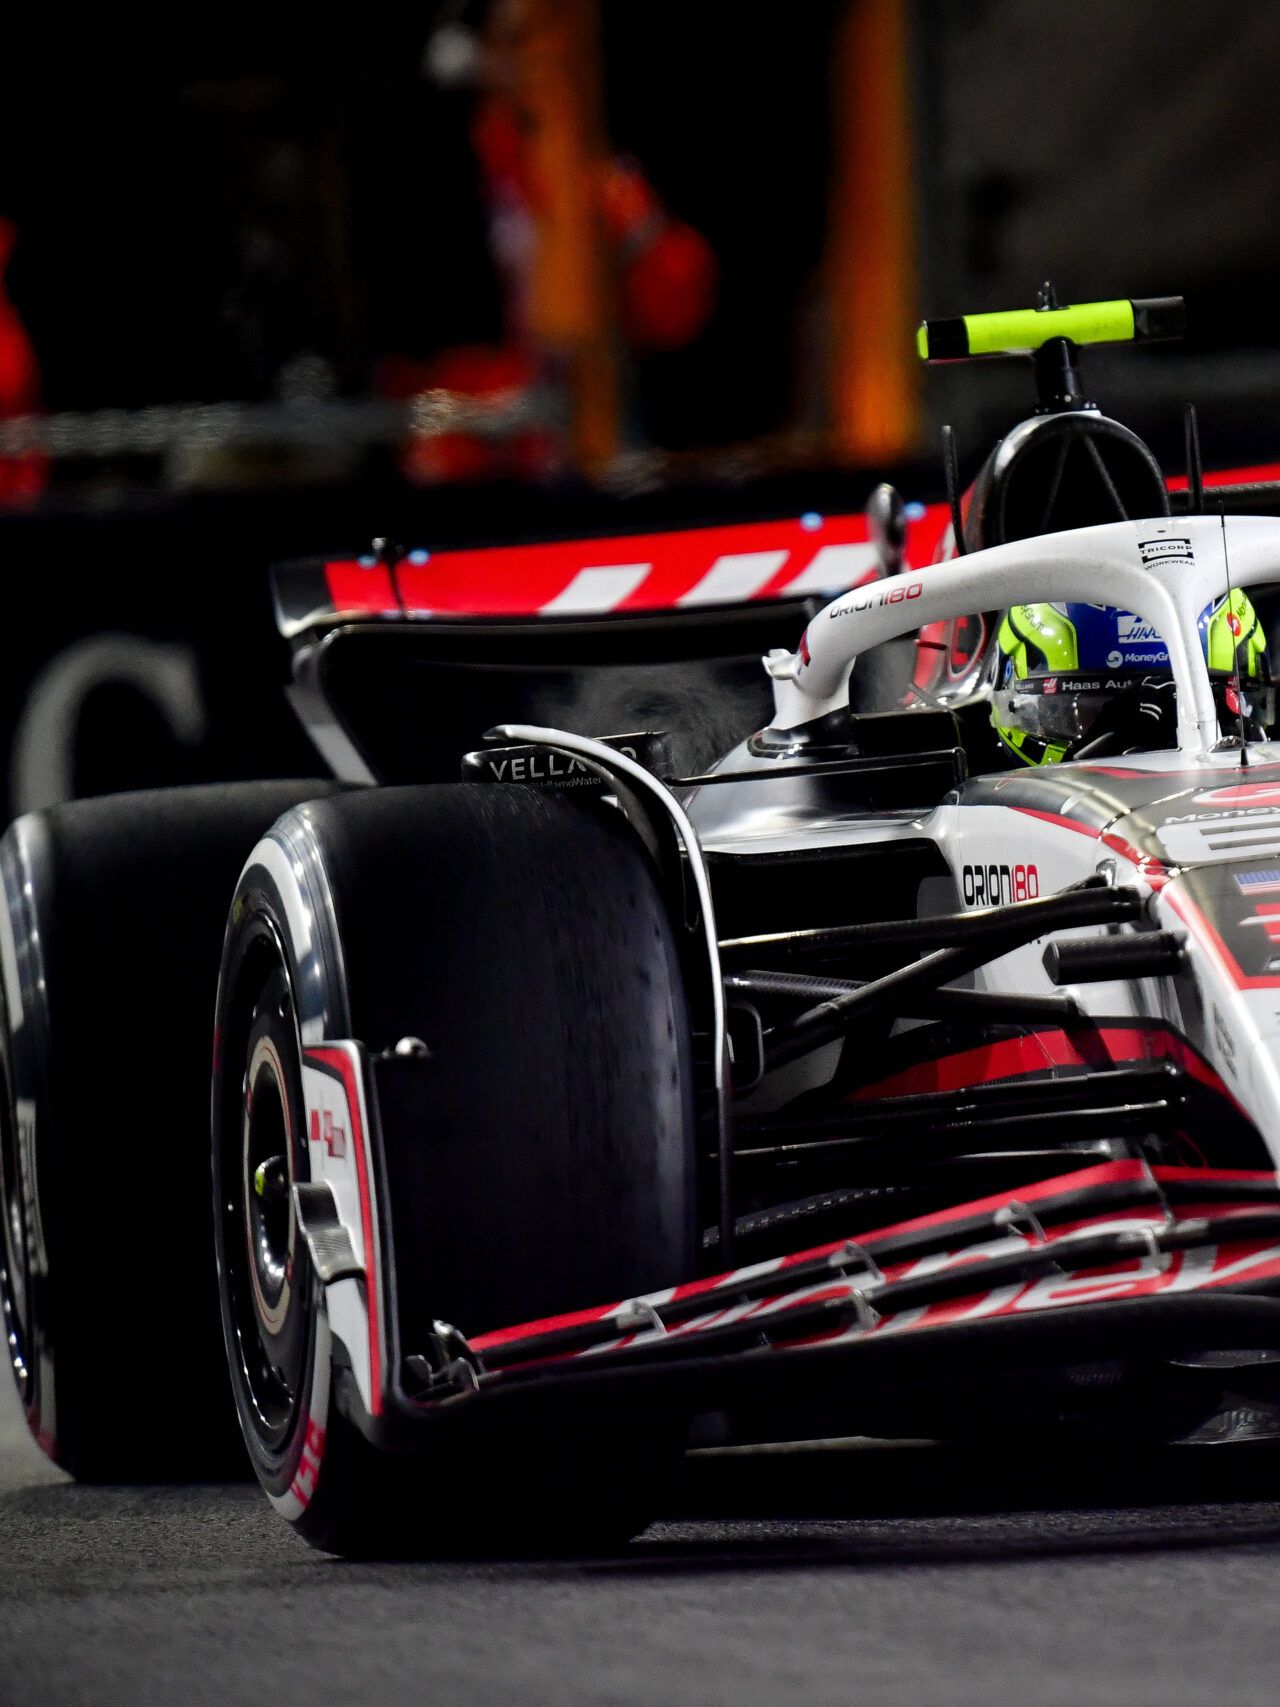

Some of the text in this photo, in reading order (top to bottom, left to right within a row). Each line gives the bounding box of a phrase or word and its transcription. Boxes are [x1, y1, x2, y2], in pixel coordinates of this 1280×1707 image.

[1125, 651, 1169, 663] MoneyGr
[1062, 680, 1101, 691] Haas
[963, 865, 1039, 906] ORION180
